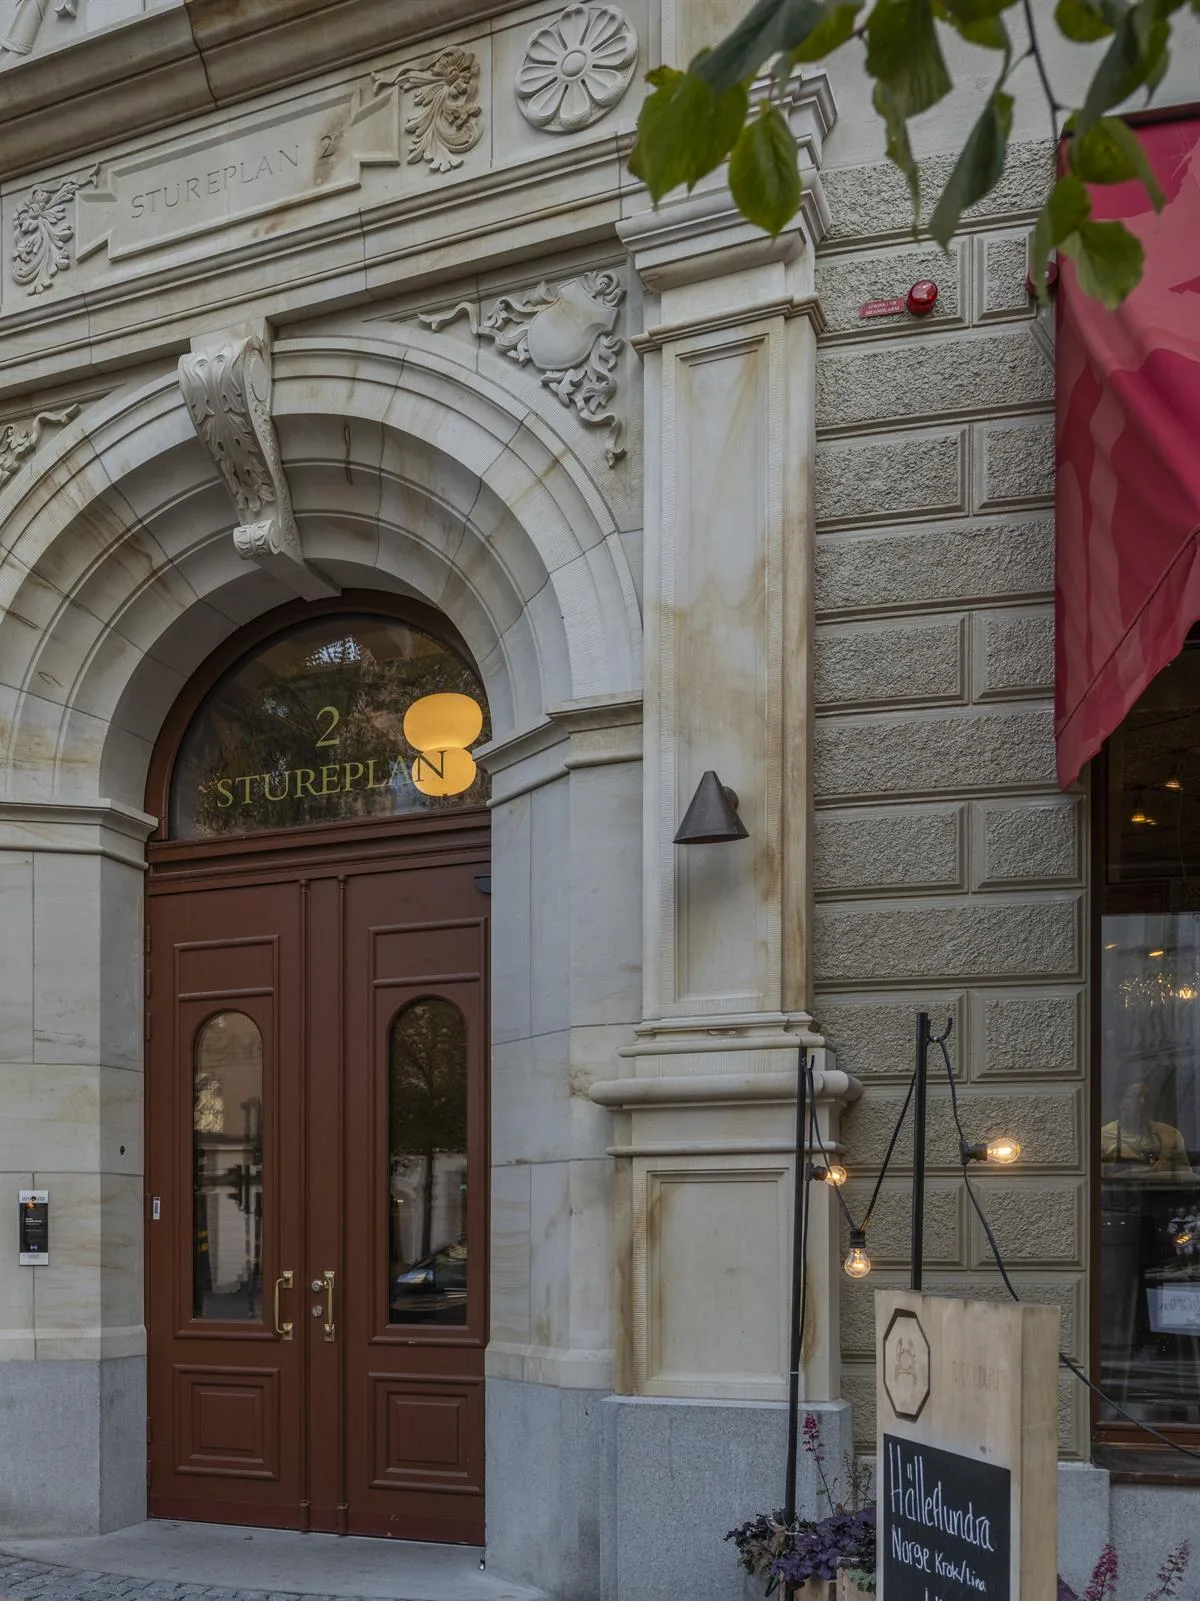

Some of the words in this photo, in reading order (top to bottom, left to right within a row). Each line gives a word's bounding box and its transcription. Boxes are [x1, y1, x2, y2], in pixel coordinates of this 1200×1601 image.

[130, 144, 299, 219] STUREPLAN
[318, 135, 336, 161] 2
[315, 706, 340, 747] 2
[216, 750, 447, 808] STUREPLAN
[888, 1442, 995, 1552] Hälleflundra
[892, 1524, 932, 1573] Norge
